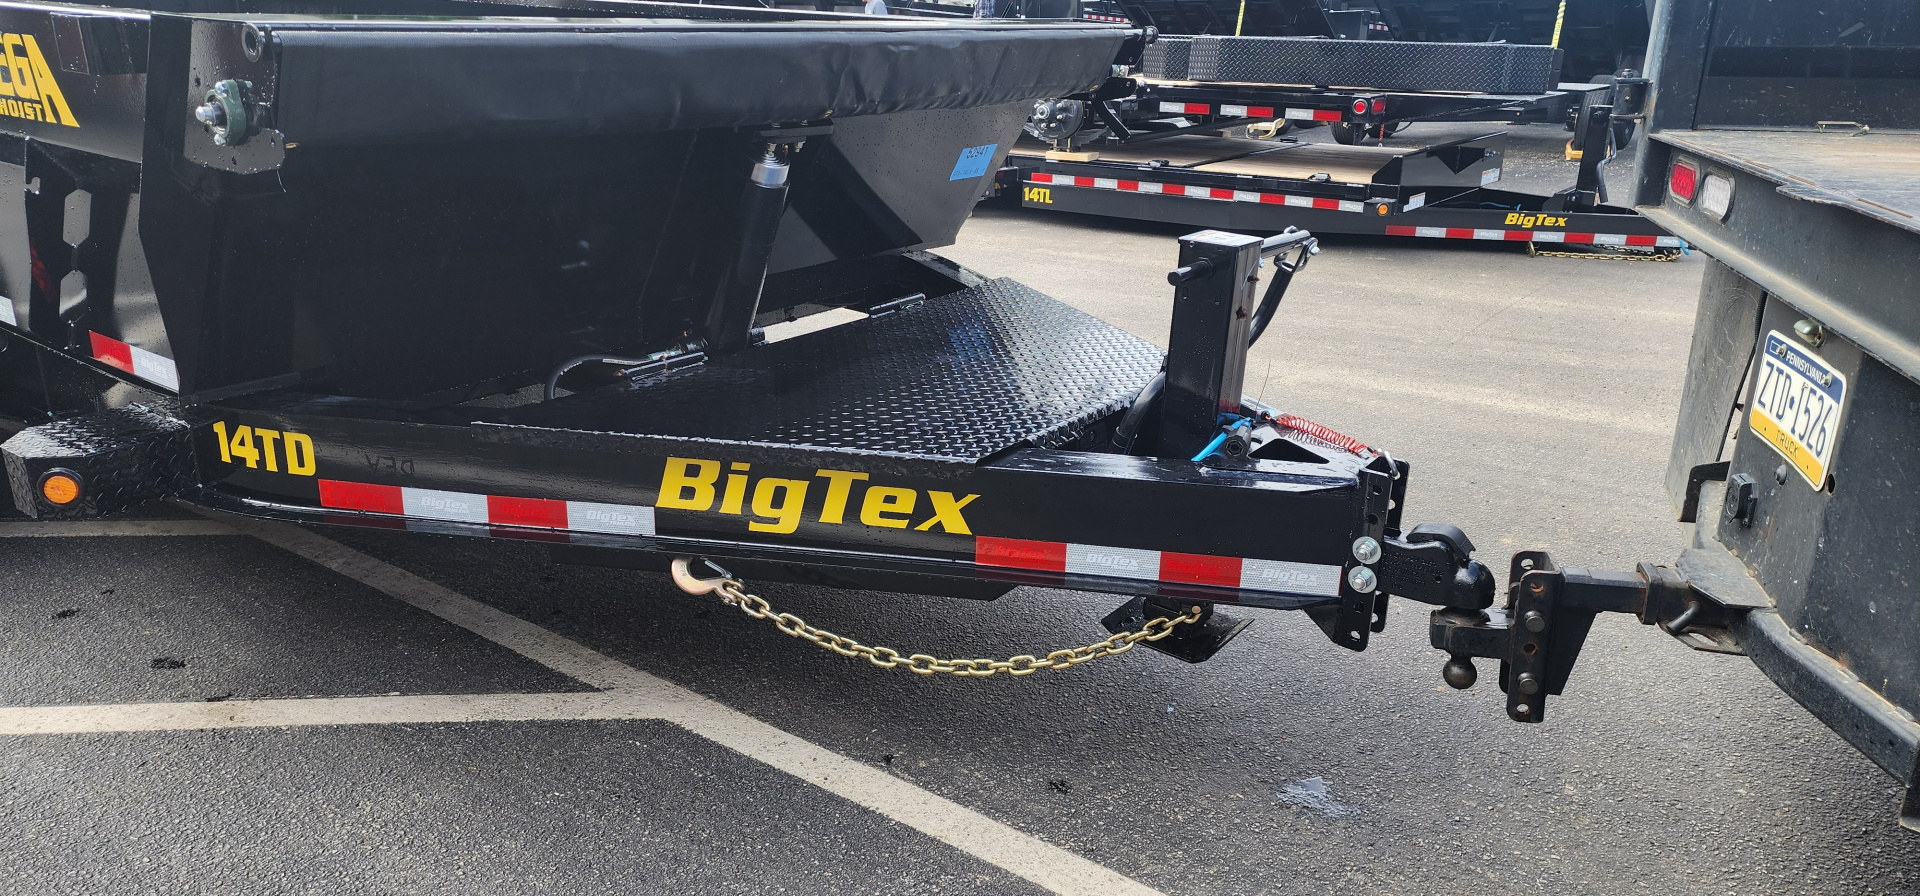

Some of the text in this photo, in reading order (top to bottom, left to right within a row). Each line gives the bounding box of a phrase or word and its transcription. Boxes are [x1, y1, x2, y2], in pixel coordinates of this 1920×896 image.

[1023, 187, 1053, 203] 14TL
[1504, 213, 1568, 228] BigTex
[213, 420, 317, 476] 14TD
[1775, 429, 1799, 460] TRUCK
[421, 496, 470, 510] BigTex
[655, 457, 982, 534] BigTex
[586, 510, 636, 523] BigTex
[1086, 553, 1140, 567] BigTex
[1262, 569, 1321, 582] BigTex
